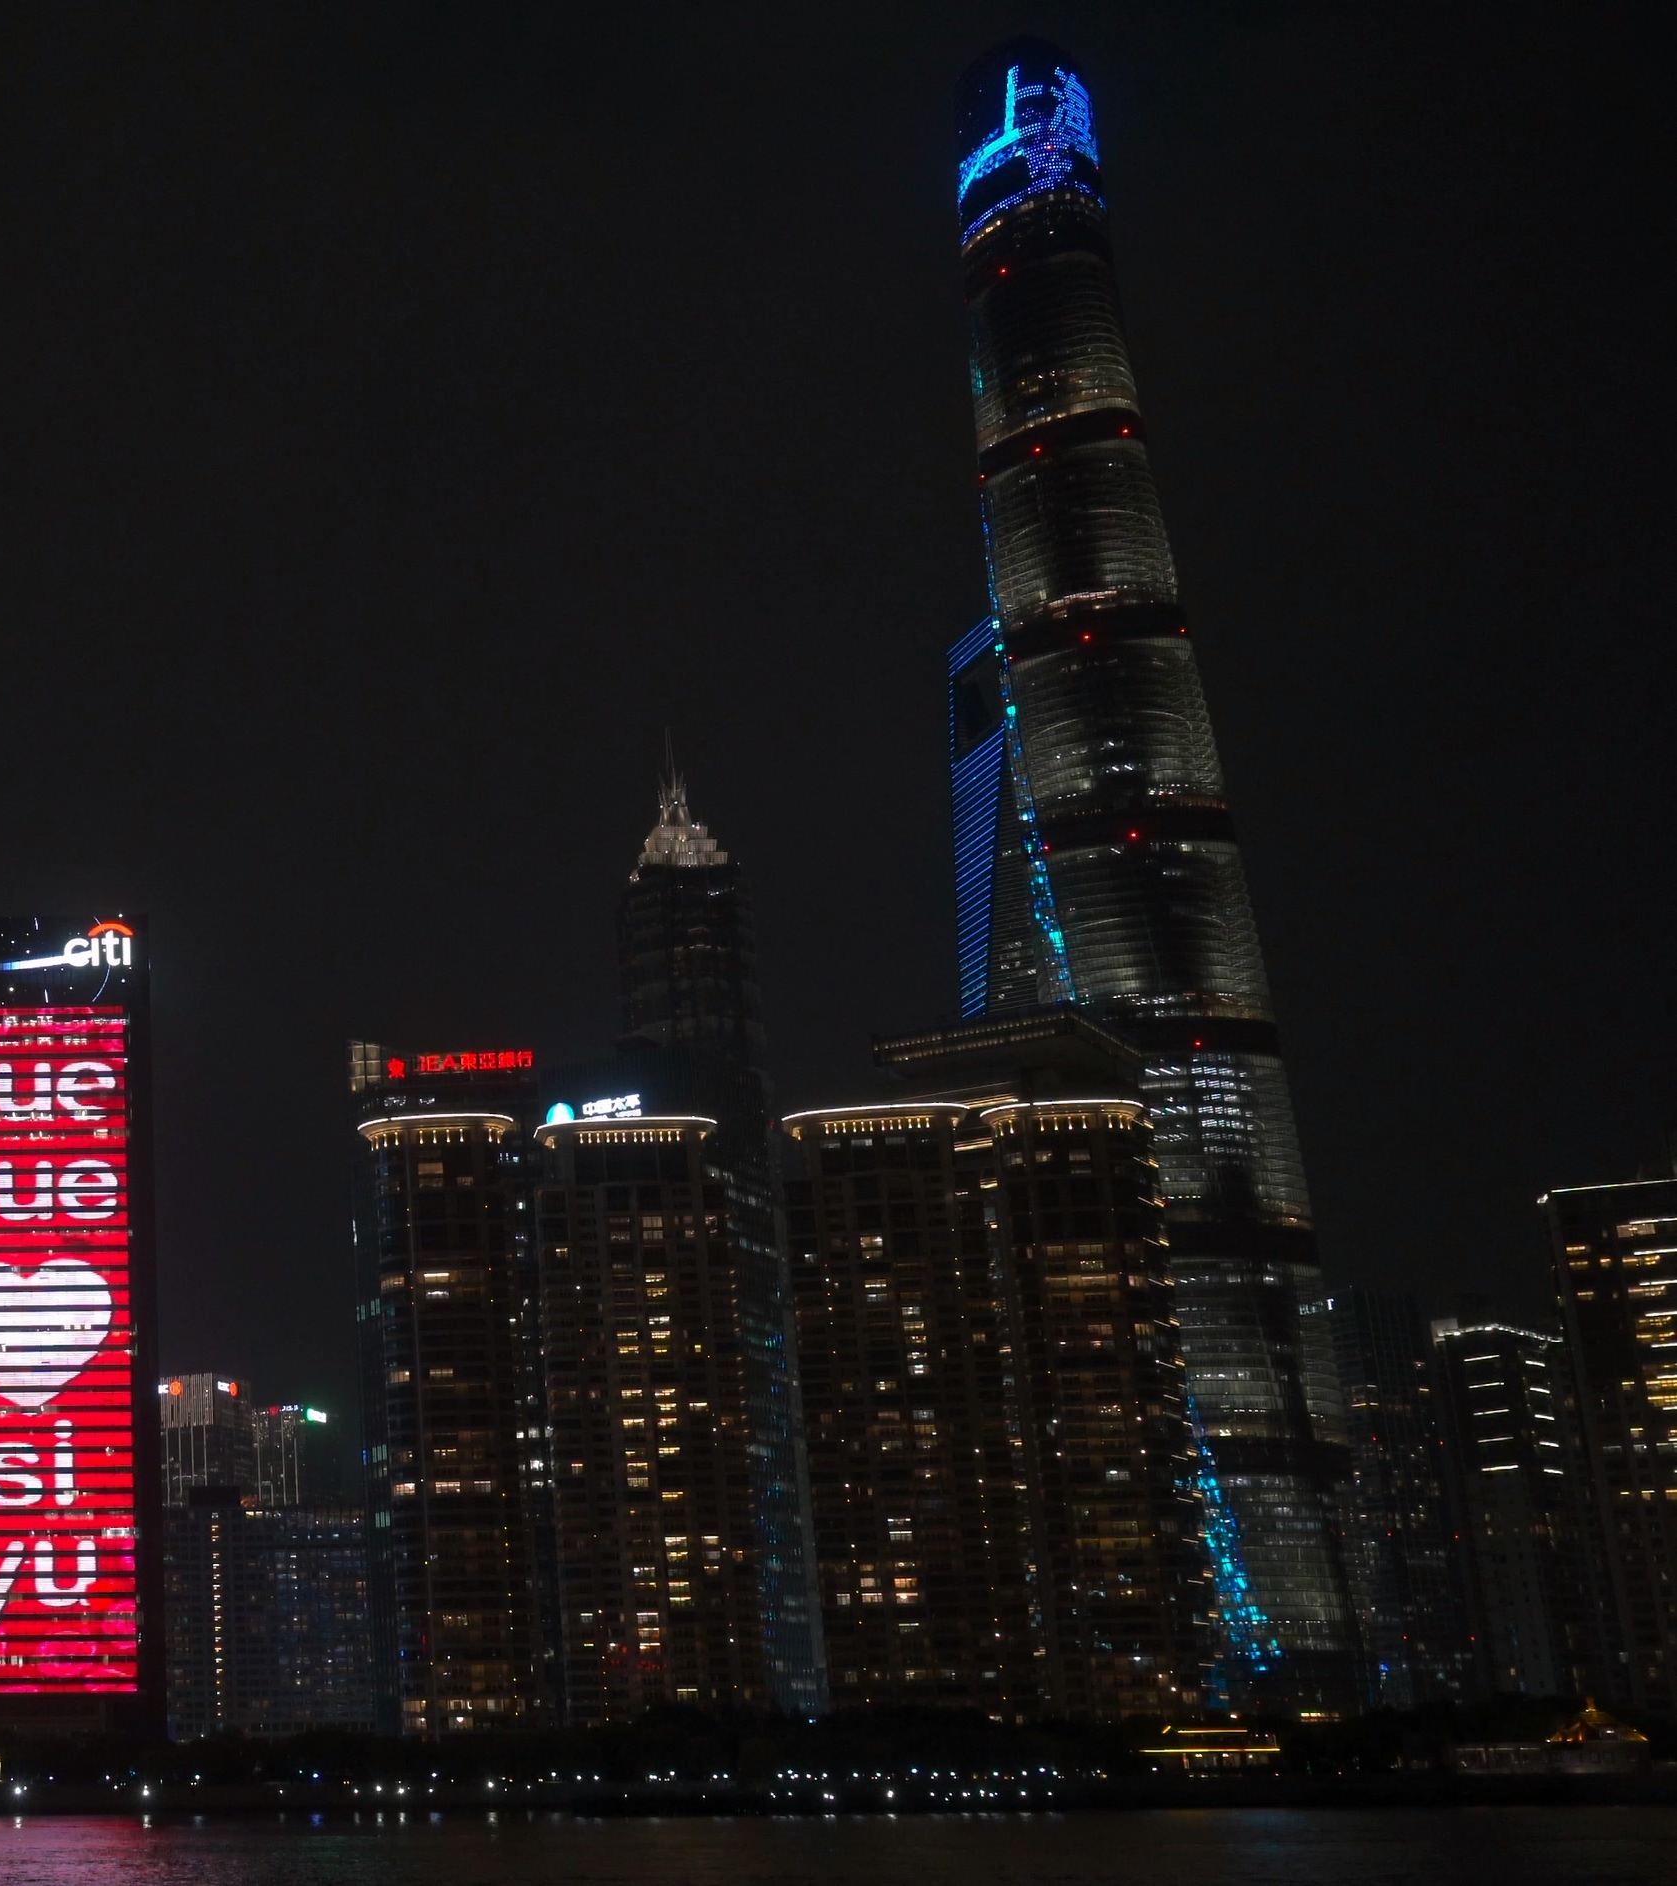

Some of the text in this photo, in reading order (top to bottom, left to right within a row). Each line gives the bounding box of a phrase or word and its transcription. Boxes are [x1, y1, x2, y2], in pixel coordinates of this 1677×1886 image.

[63, 929, 133, 967] citi
[460, 1051, 534, 1070] 東亞銀行
